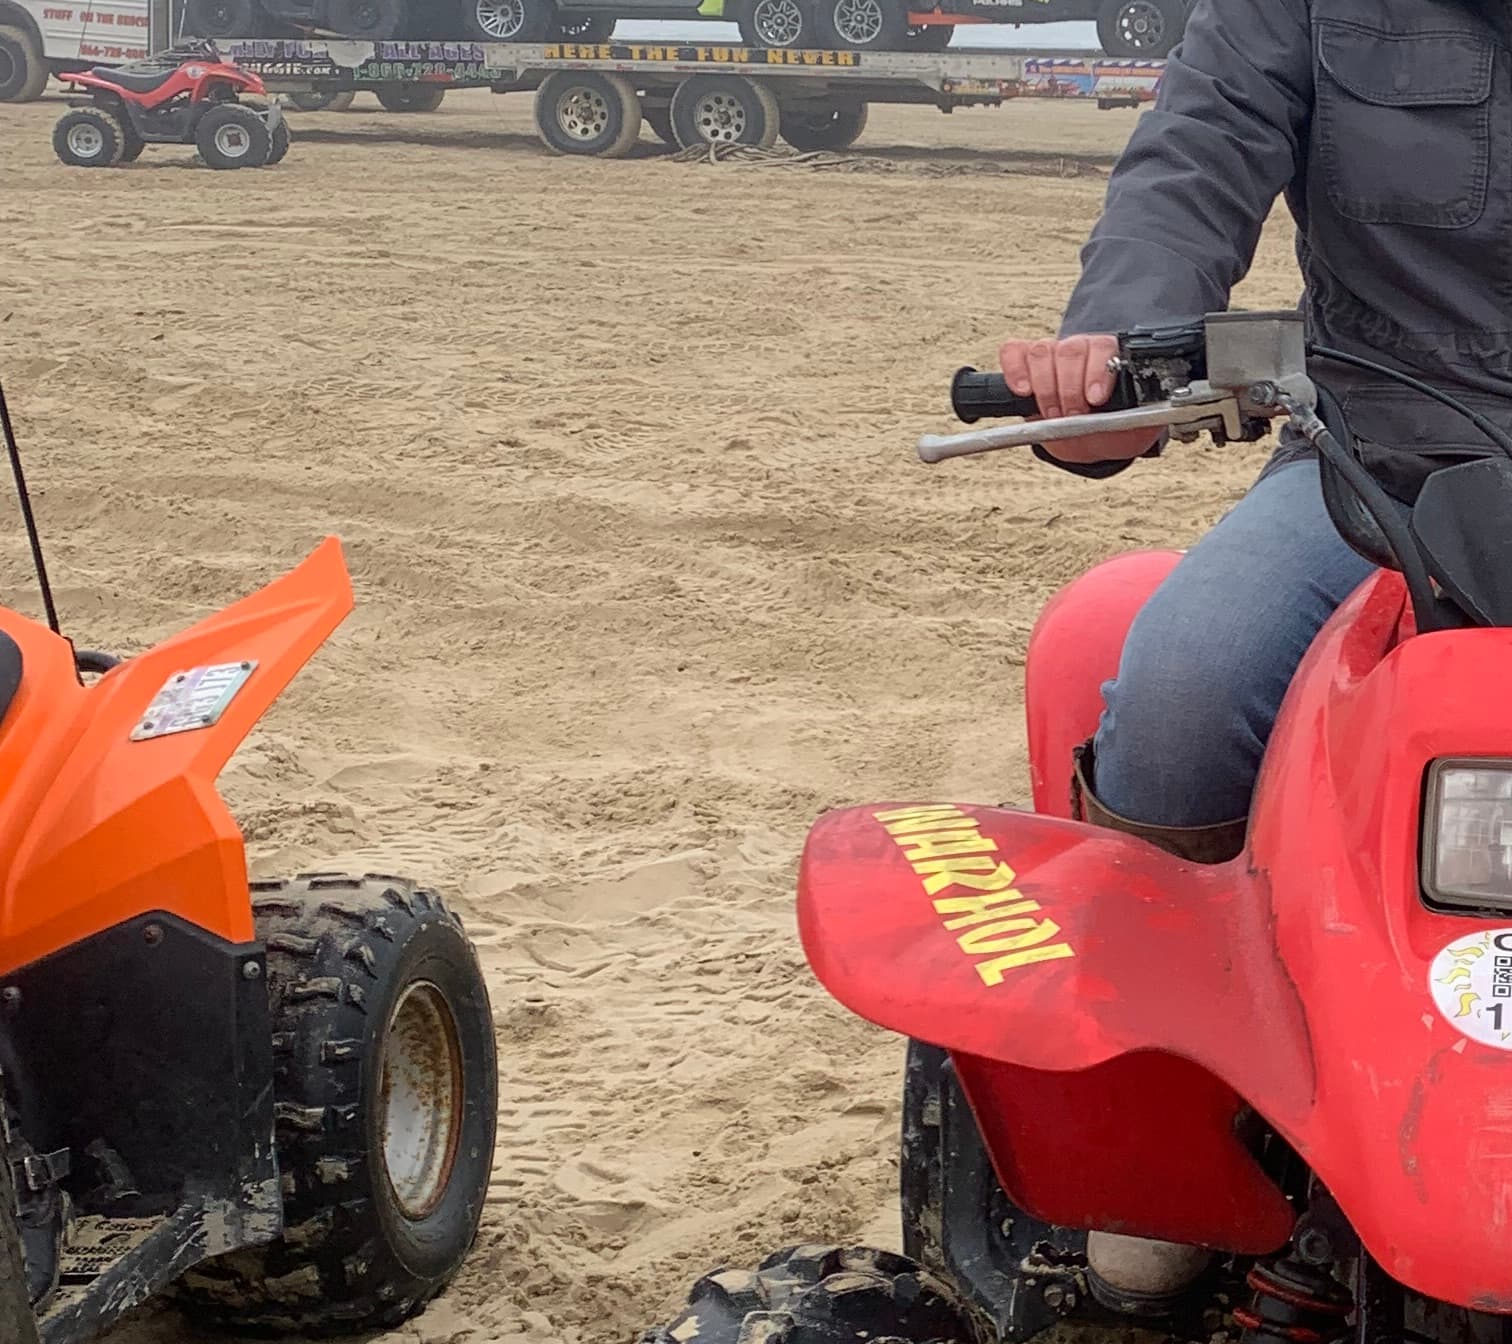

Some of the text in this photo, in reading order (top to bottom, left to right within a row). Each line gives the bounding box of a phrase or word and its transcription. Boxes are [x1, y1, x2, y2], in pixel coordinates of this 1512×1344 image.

[628, 45, 680, 61] THE
[697, 47, 749, 64] FUN
[766, 49, 855, 66] NEVER
[872, 804, 1076, 987] WARHOL
